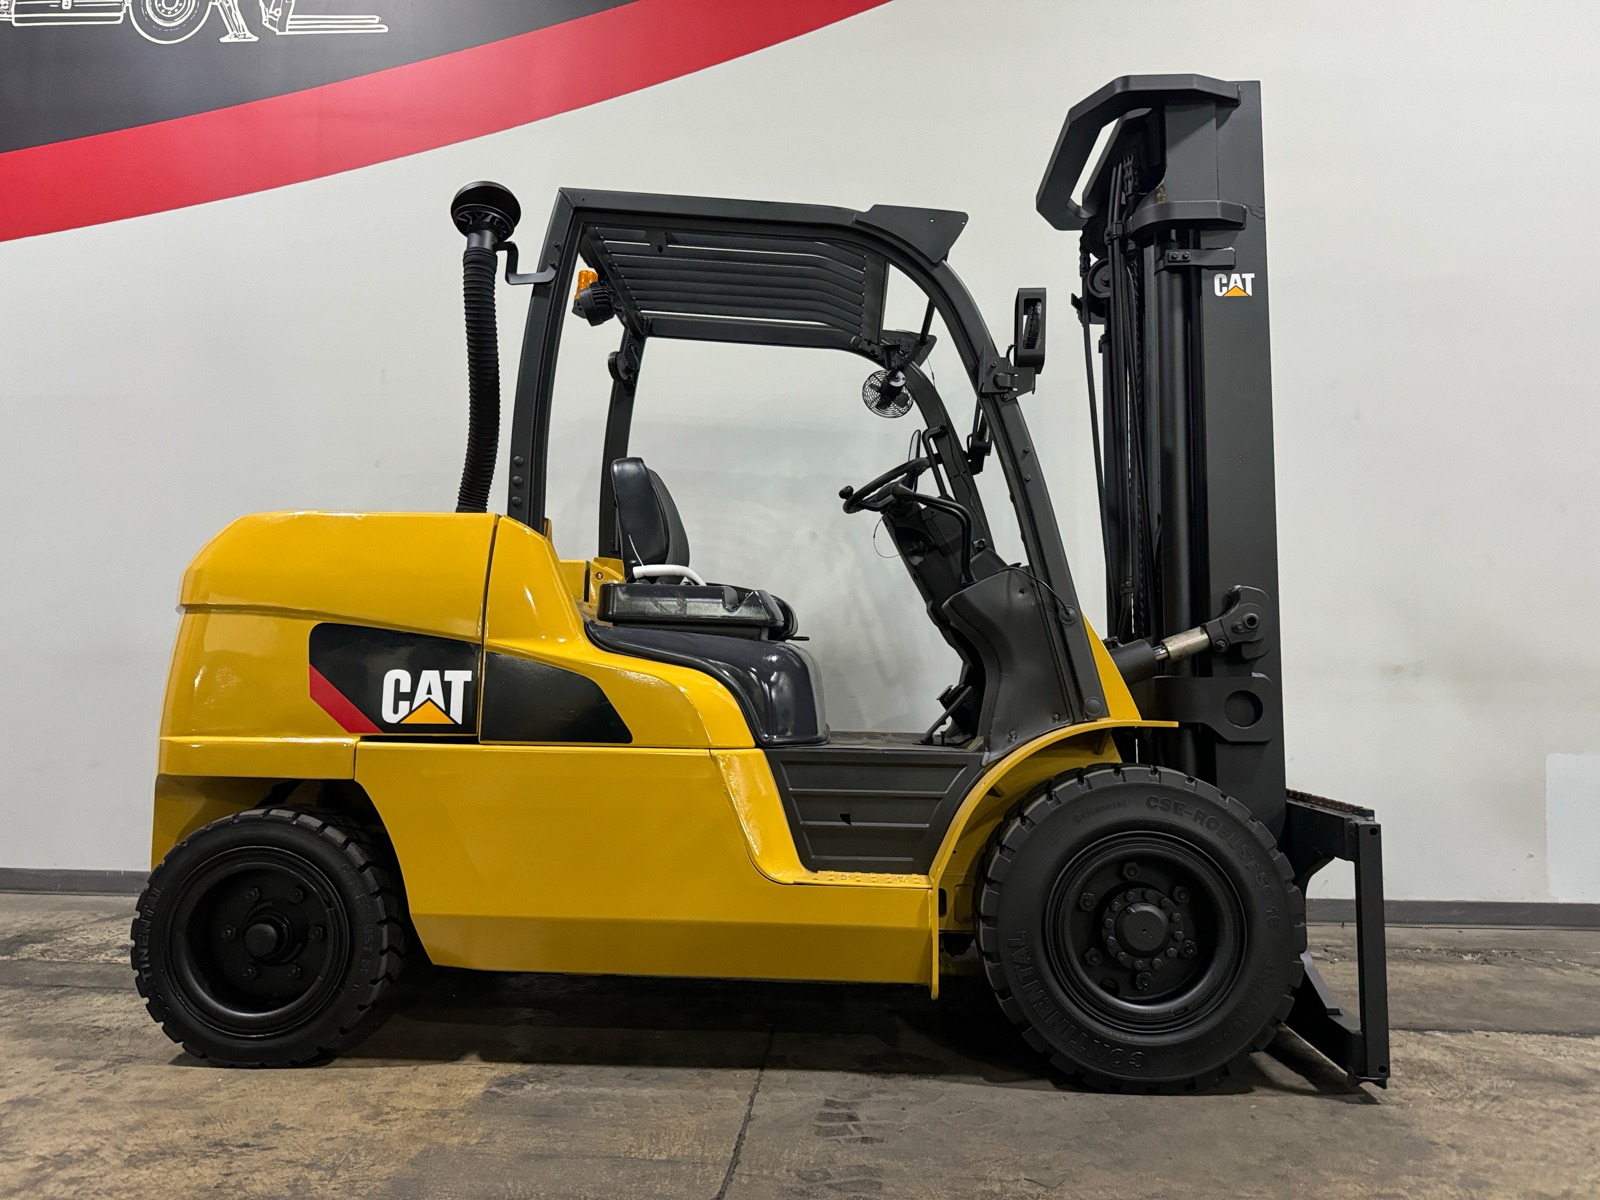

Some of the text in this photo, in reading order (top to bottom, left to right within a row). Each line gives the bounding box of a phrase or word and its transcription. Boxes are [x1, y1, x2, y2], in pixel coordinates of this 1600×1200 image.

[1214, 273, 1255, 297] CAT
[382, 669, 472, 724] CAT
[1007, 929, 1146, 1073] CONTINENTAL
